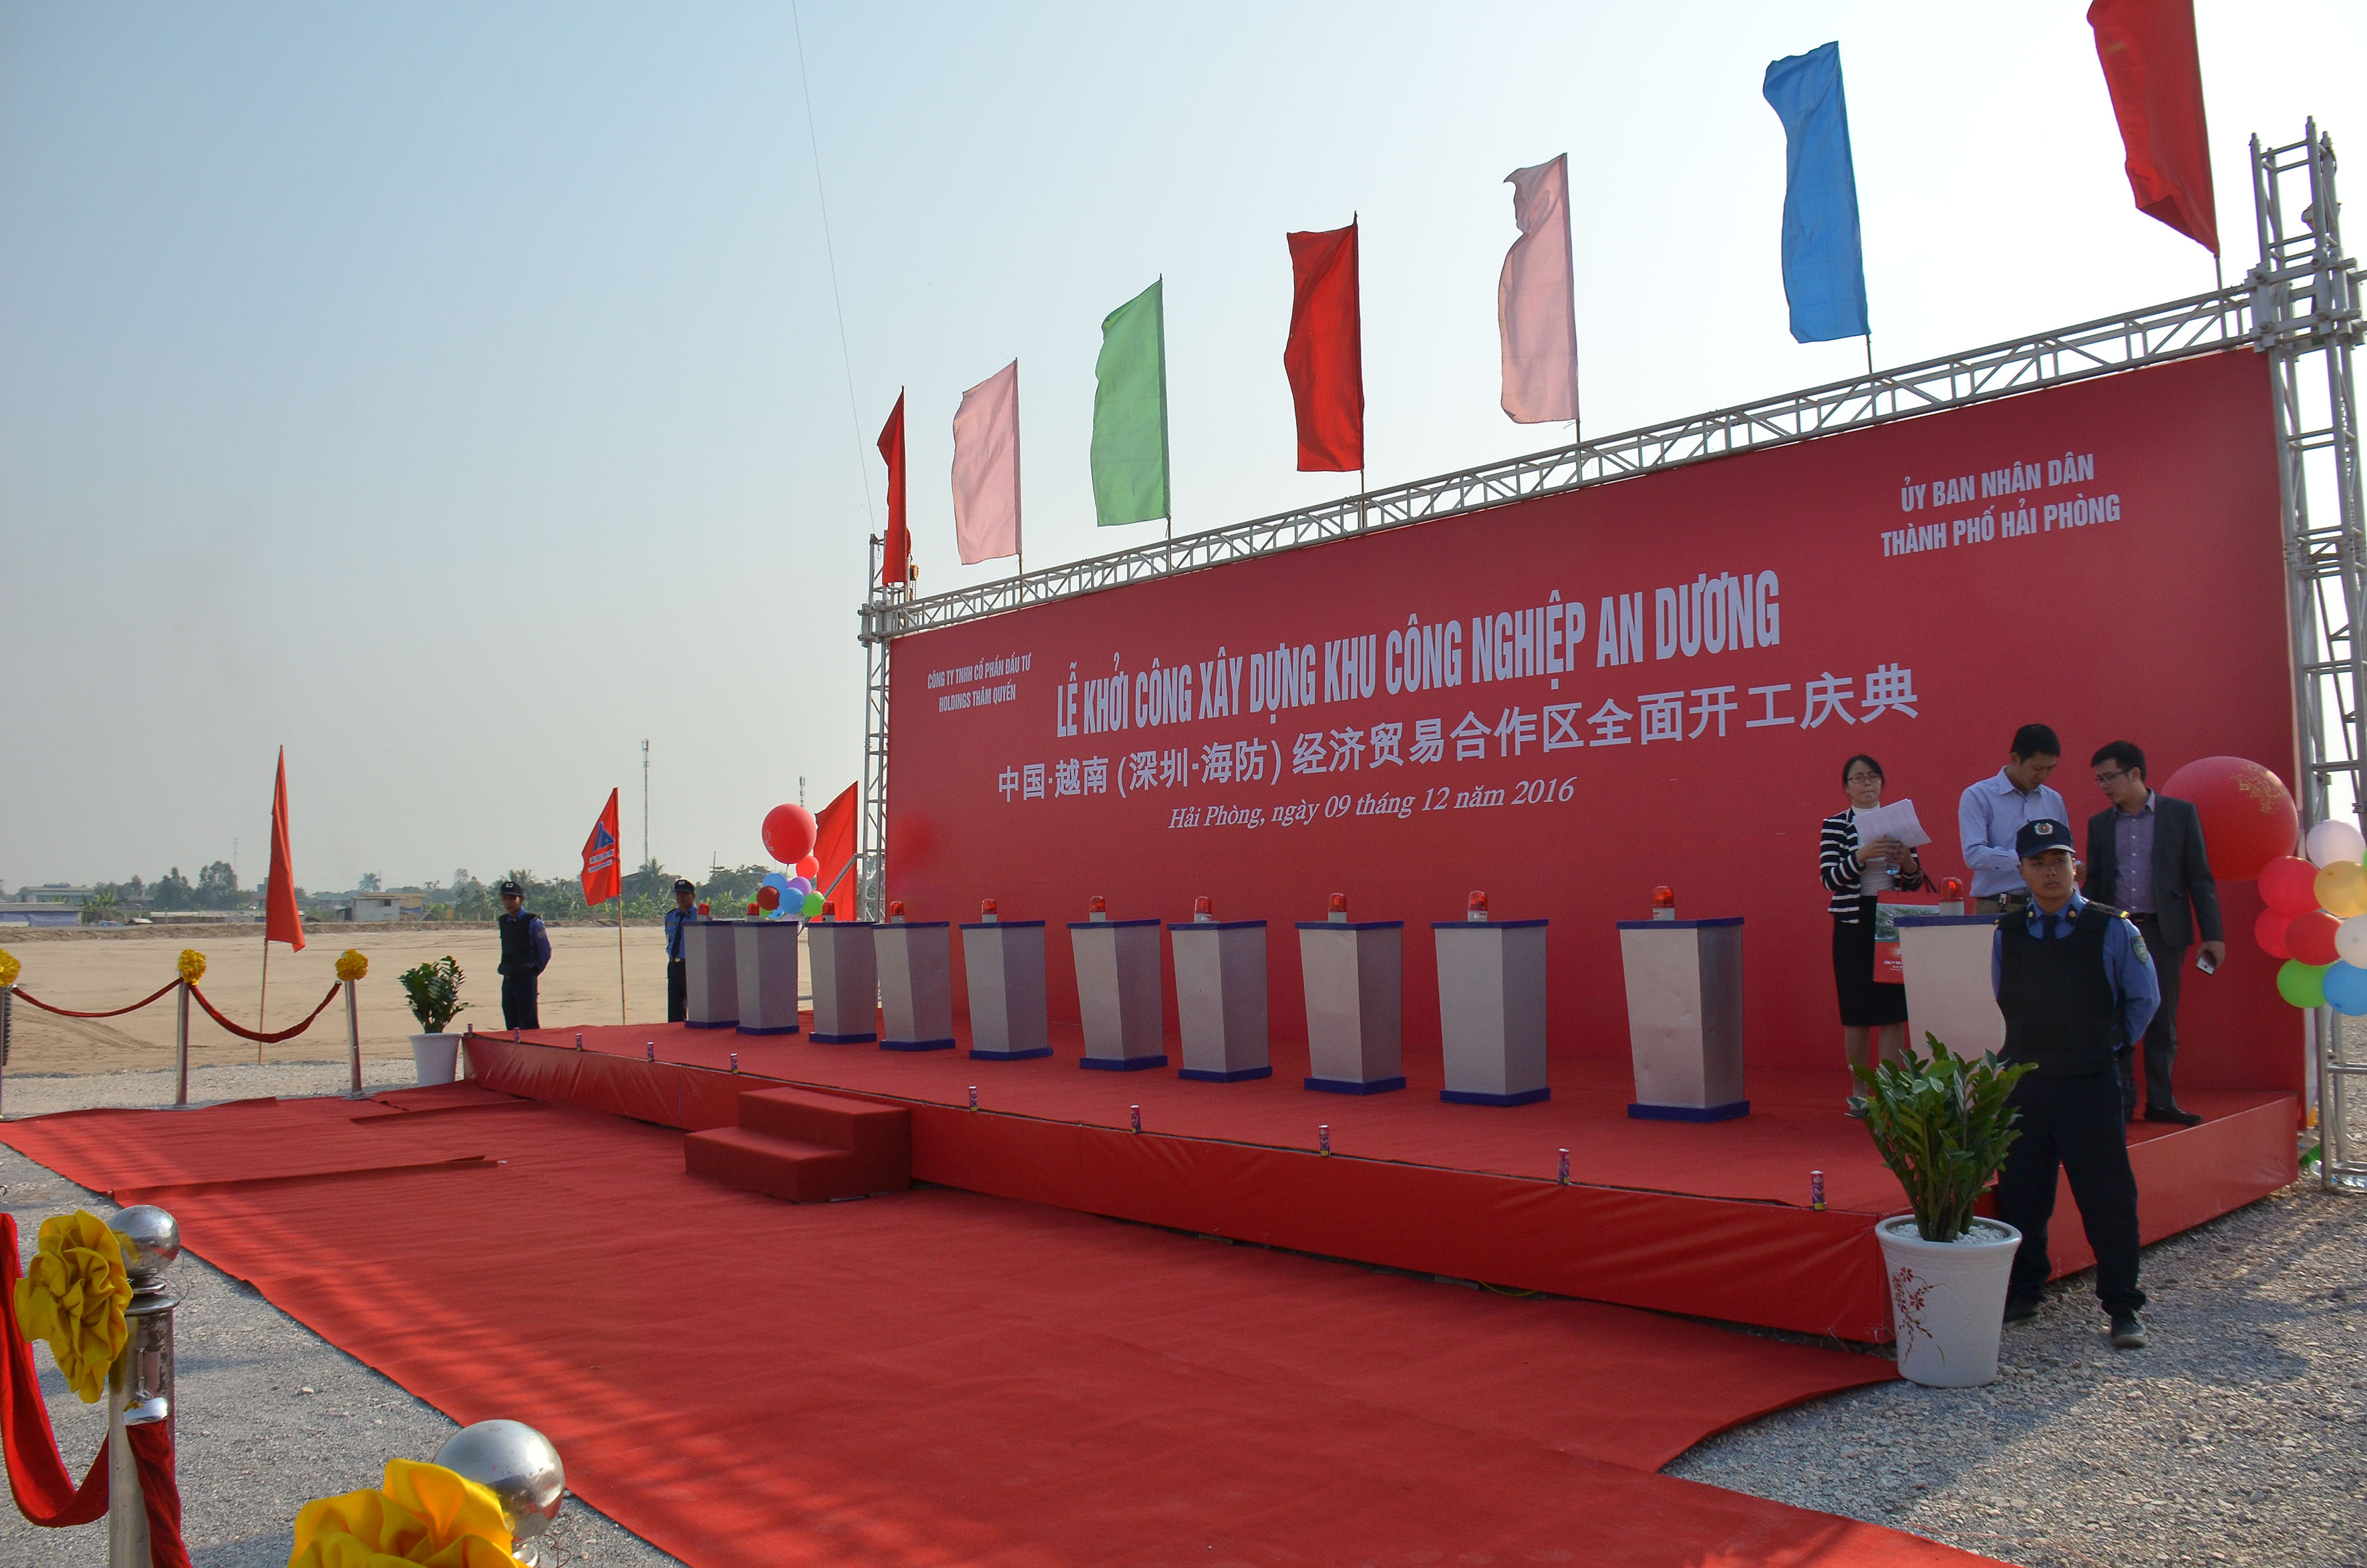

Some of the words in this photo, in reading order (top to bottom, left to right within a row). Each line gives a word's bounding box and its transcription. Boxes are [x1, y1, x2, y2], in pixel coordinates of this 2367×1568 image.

[1901, 476, 1926, 512] ỦY
[1932, 475, 1976, 507] BAN
[1982, 461, 2042, 498] NHÂN
[2048, 451, 2094, 486] DÂN
[1881, 522, 1947, 557] THÀNH
[1953, 504, 1995, 546] PHỐ
[2001, 498, 2037, 538] HẢI
[2043, 493, 2120, 532] PHÒNG
[927, 669, 945, 689] CÔNG
[946, 669, 955, 686] TY
[955, 665, 973, 684] TNHH
[1021, 652, 1032, 672] TƯ
[1057, 661, 1078, 738] LỄ
[1083, 651, 1129, 735] KHỞI
[1135, 657, 1193, 728] CÔNG
[1198, 646, 1243, 720] XÂY
[1249, 642, 1316, 724] DỰNG
[1324, 634, 1376, 703] KHU
[1385, 613, 1462, 695] CÔNG
[1472, 589, 1586, 690] NGHIỆP
[1596, 591, 1643, 668] AN
[1655, 570, 1780, 660] DƯƠNG
[939, 691, 971, 713] HOLDINGS
[972, 685, 991, 706] THÂM
[1168, 806, 1201, 828] Hải
[1203, 804, 1265, 829] Phòng,
[1271, 798, 1321, 827] ngày
[1324, 794, 1352, 818] 09
[1356, 792, 1416, 819] tháng
[1421, 786, 1450, 811] 12
[1456, 785, 1505, 808] năm
[1511, 776, 1577, 805] 2016
